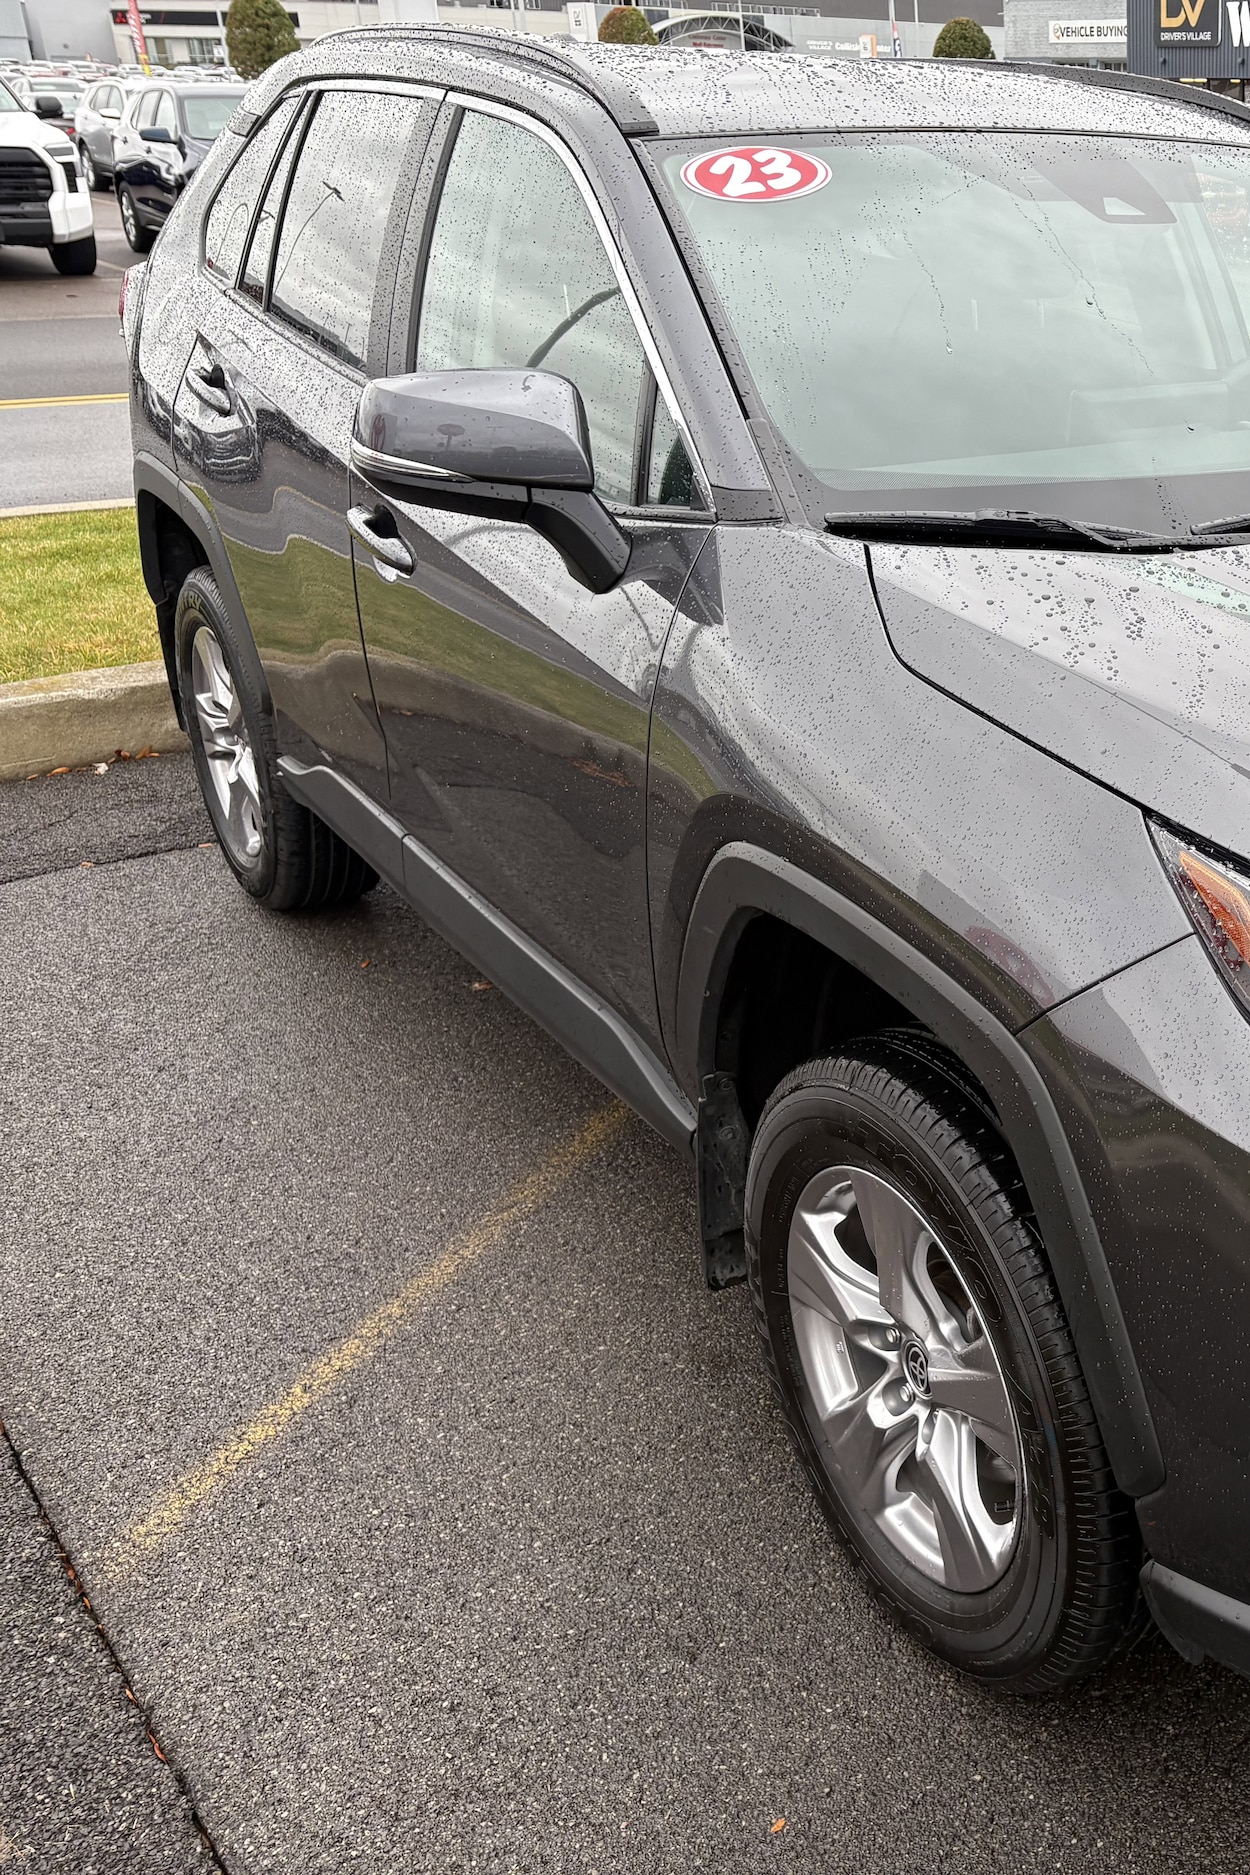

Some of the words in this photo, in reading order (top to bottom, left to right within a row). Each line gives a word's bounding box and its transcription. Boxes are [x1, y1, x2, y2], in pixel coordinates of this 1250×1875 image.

[1059, 26, 1095, 38] VEHICLE
[1186, 31, 1212, 41] VILLAGE
[835, 41, 860, 51] Collisi
[709, 149, 802, 197] 23
